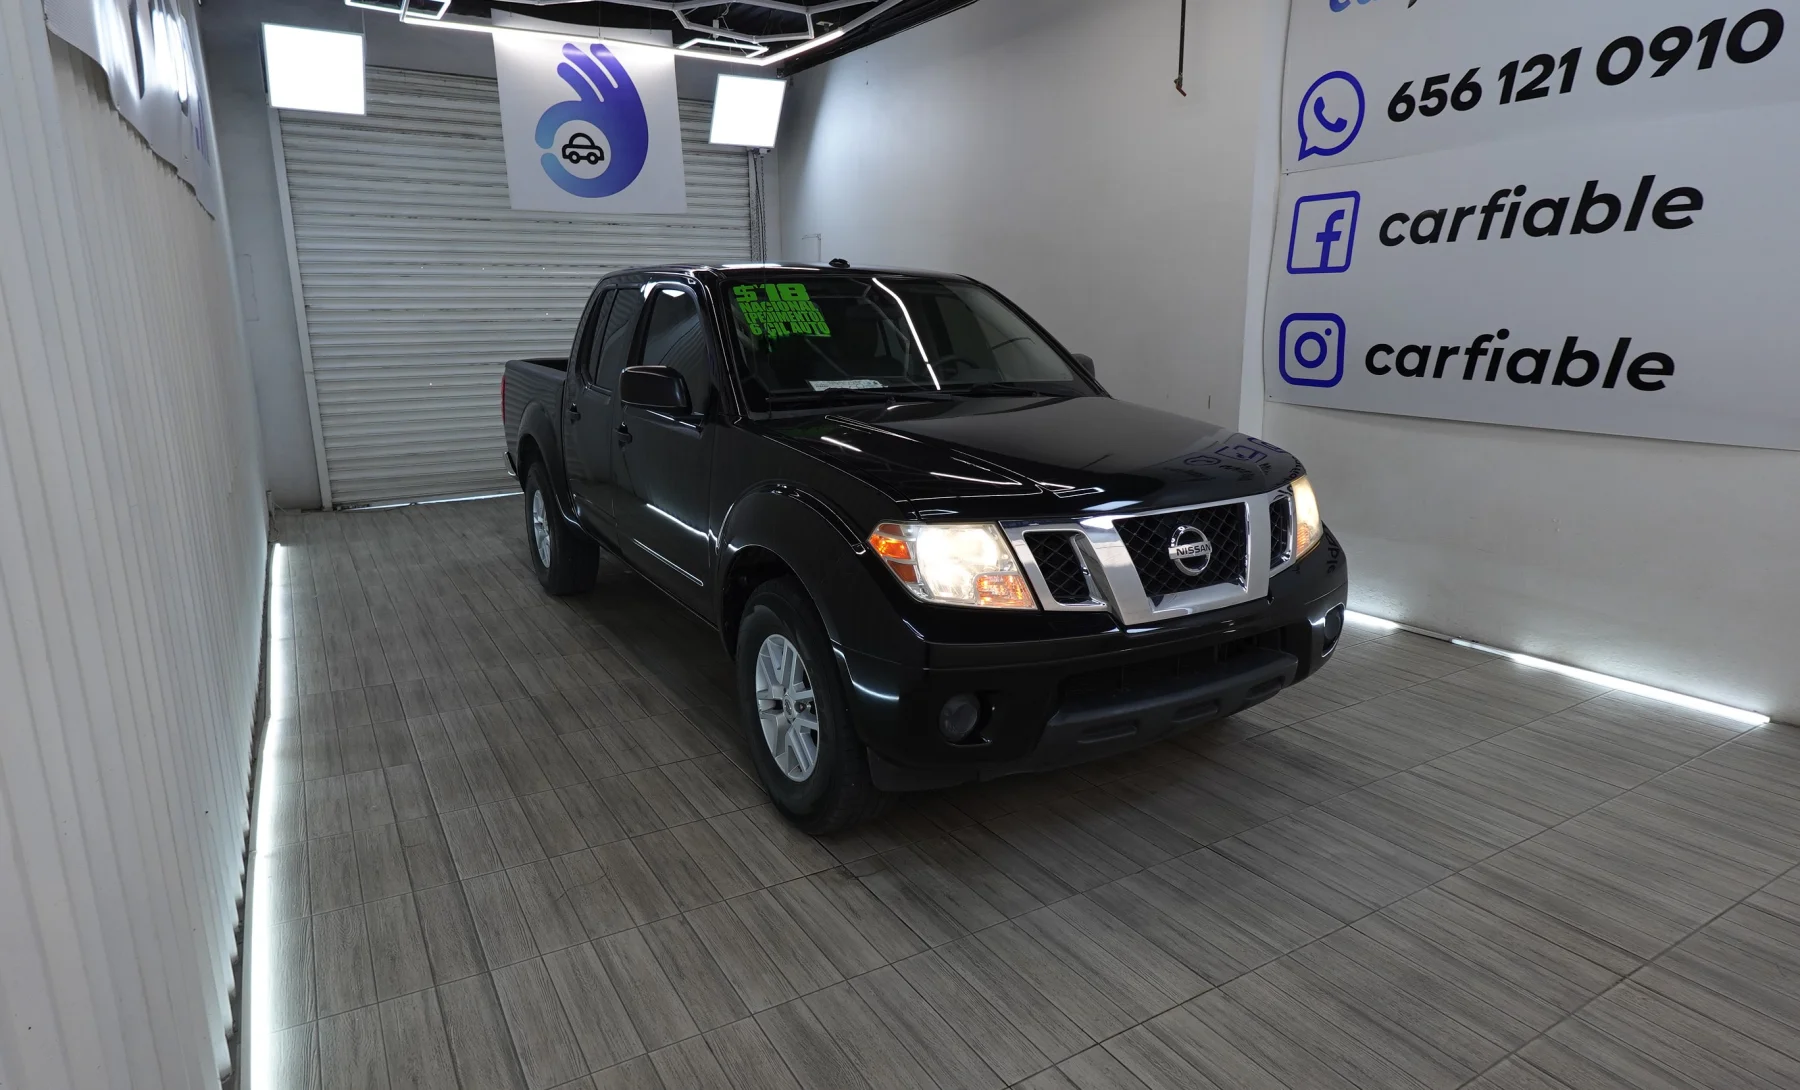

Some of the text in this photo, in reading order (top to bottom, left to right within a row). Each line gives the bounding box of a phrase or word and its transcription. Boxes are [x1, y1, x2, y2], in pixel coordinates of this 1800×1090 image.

[1387, 8, 1785, 123] 656 121 0910
[1379, 174, 1704, 247] carfiable
[739, 301, 819, 313] NACIONAL
[749, 323, 763, 336] 6
[790, 321, 831, 336] AUTO
[1364, 328, 1675, 392] carfiable
[1176, 543, 1211, 556] NISSAN
